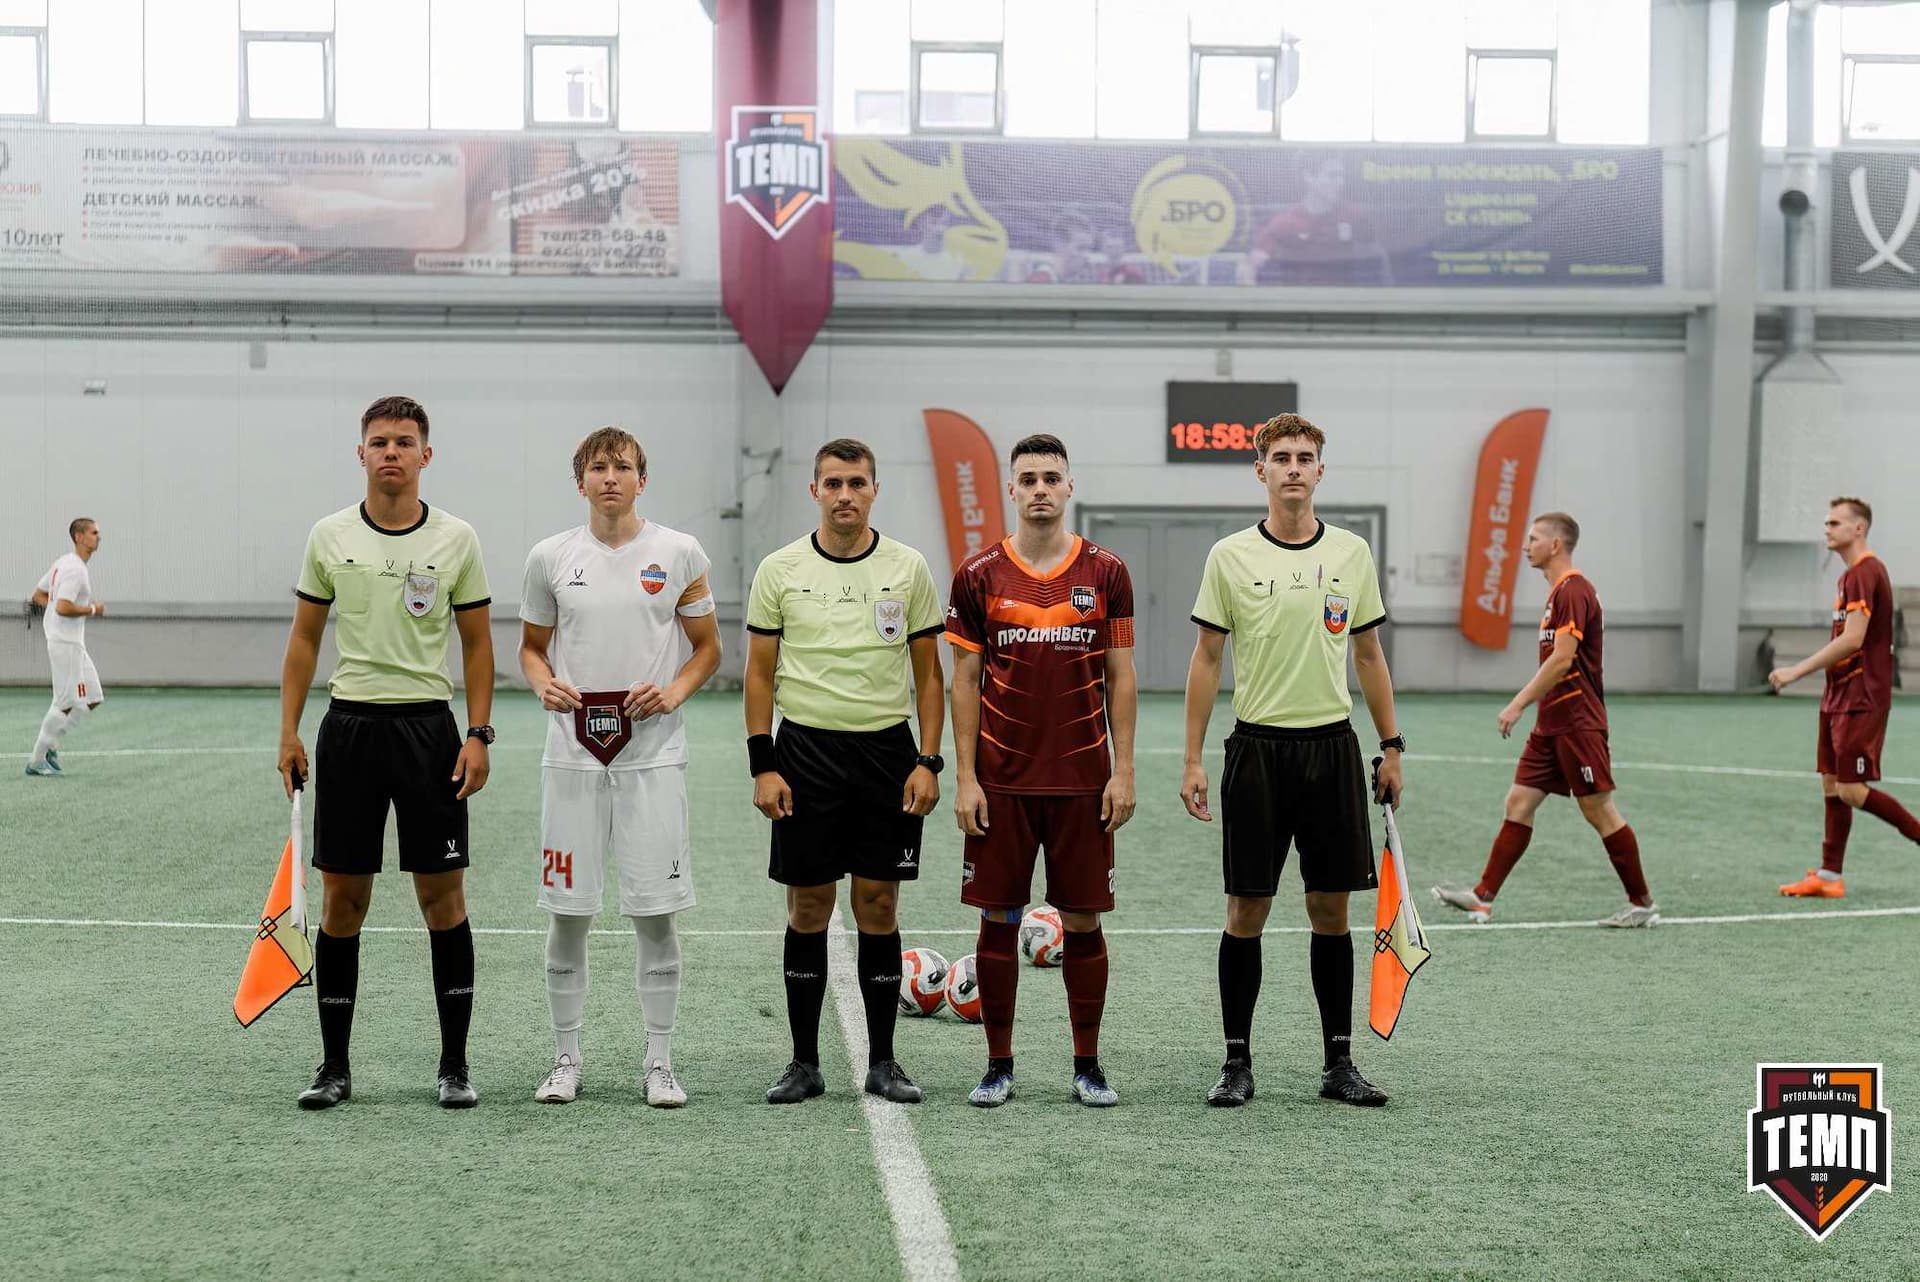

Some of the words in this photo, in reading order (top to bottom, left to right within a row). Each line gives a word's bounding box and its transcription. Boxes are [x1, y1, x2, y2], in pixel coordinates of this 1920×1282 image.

[735, 142, 819, 189] ТЕМП
[83, 190, 170, 207] ДЕТСКИЙ
[1171, 422, 1267, 450] 18:58:
[1489, 457, 1519, 525] Банк
[1073, 594, 1094, 608] ТЕМП
[998, 626, 1097, 648] ПРОДИНВЕСТ
[589, 717, 618, 733] ТЕМП
[543, 848, 573, 889] 24
